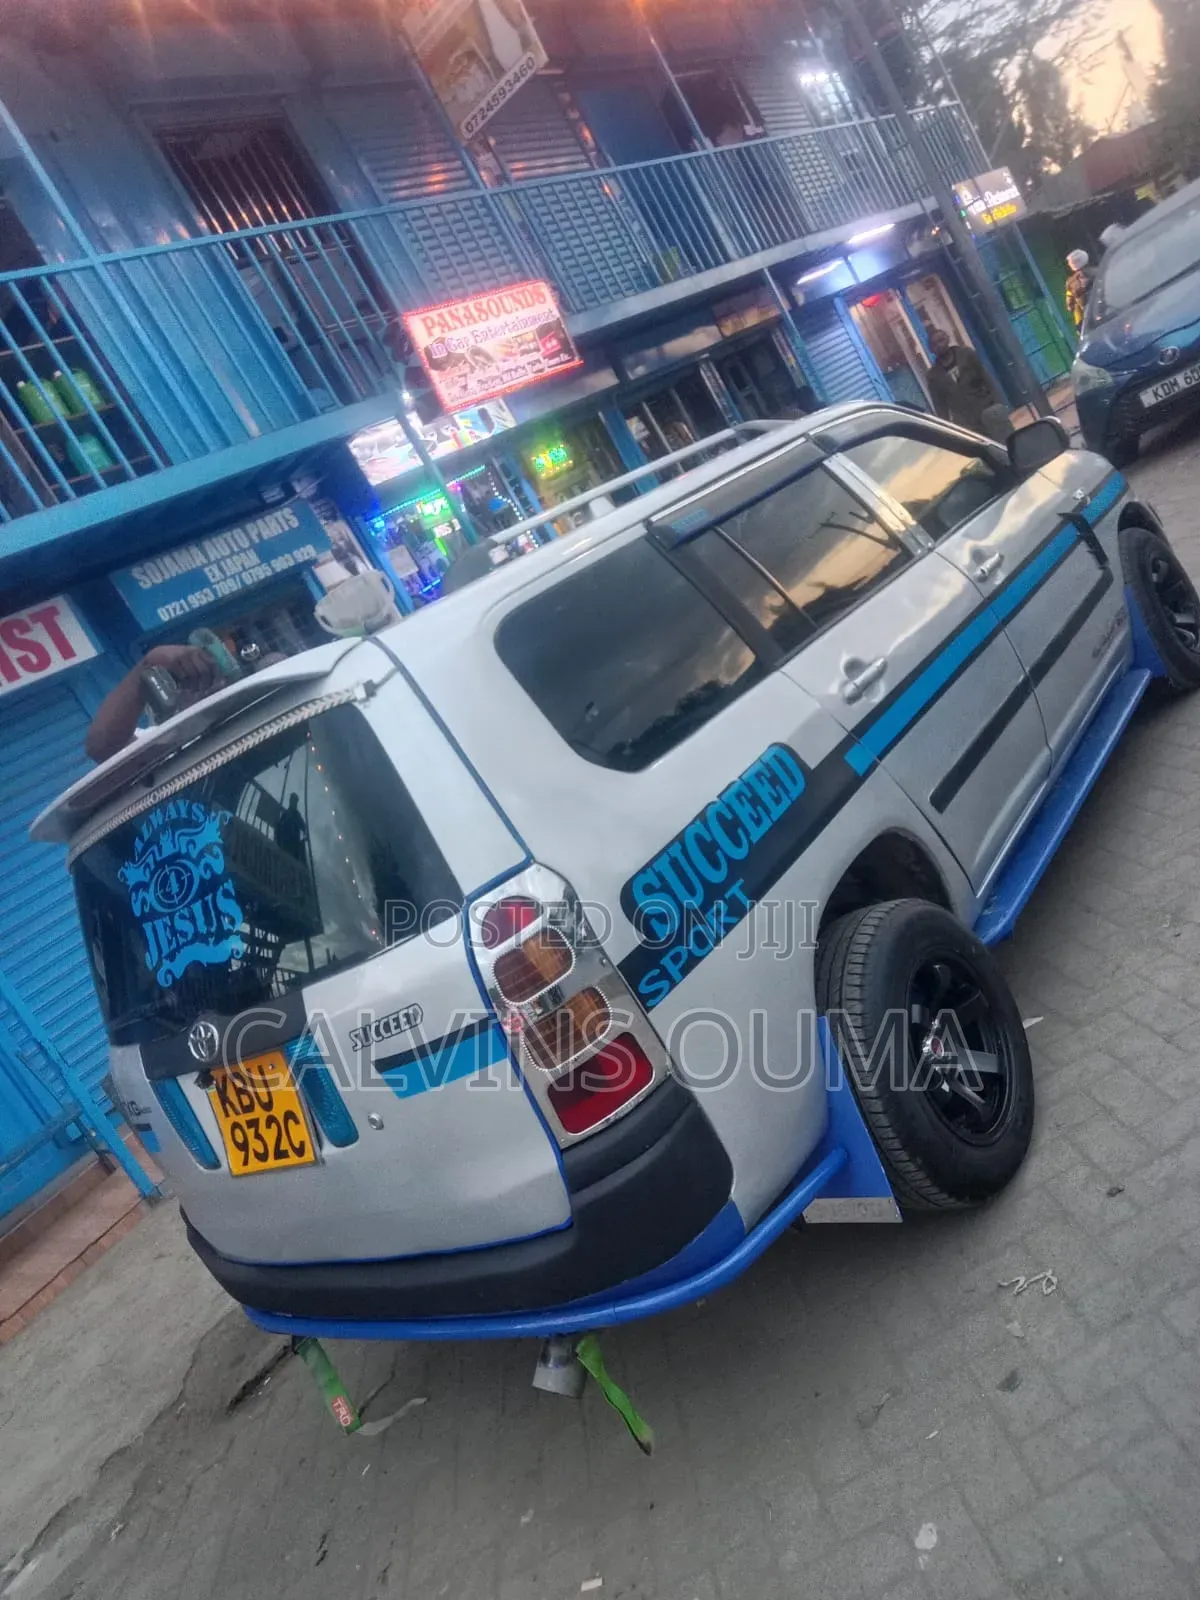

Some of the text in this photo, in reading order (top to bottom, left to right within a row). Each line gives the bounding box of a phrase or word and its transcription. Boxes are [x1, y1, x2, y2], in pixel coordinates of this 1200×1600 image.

[420, 285, 547, 338] PANASOUNDS
[471, 308, 558, 343] Entertainment
[202, 528, 250, 561] AUTO
[245, 507, 299, 544] PARTS
[204, 548, 261, 583] EX JAPAN
[157, 599, 189, 622] 0721
[632, 746, 806, 939] SUCCEED
[142, 880, 244, 971] JESUS
[638, 878, 751, 1007] SPORT
[349, 1003, 423, 1052] SUCCEED
[215, 1066, 275, 1118] KBU
[231, 1110, 306, 1166] 932C
